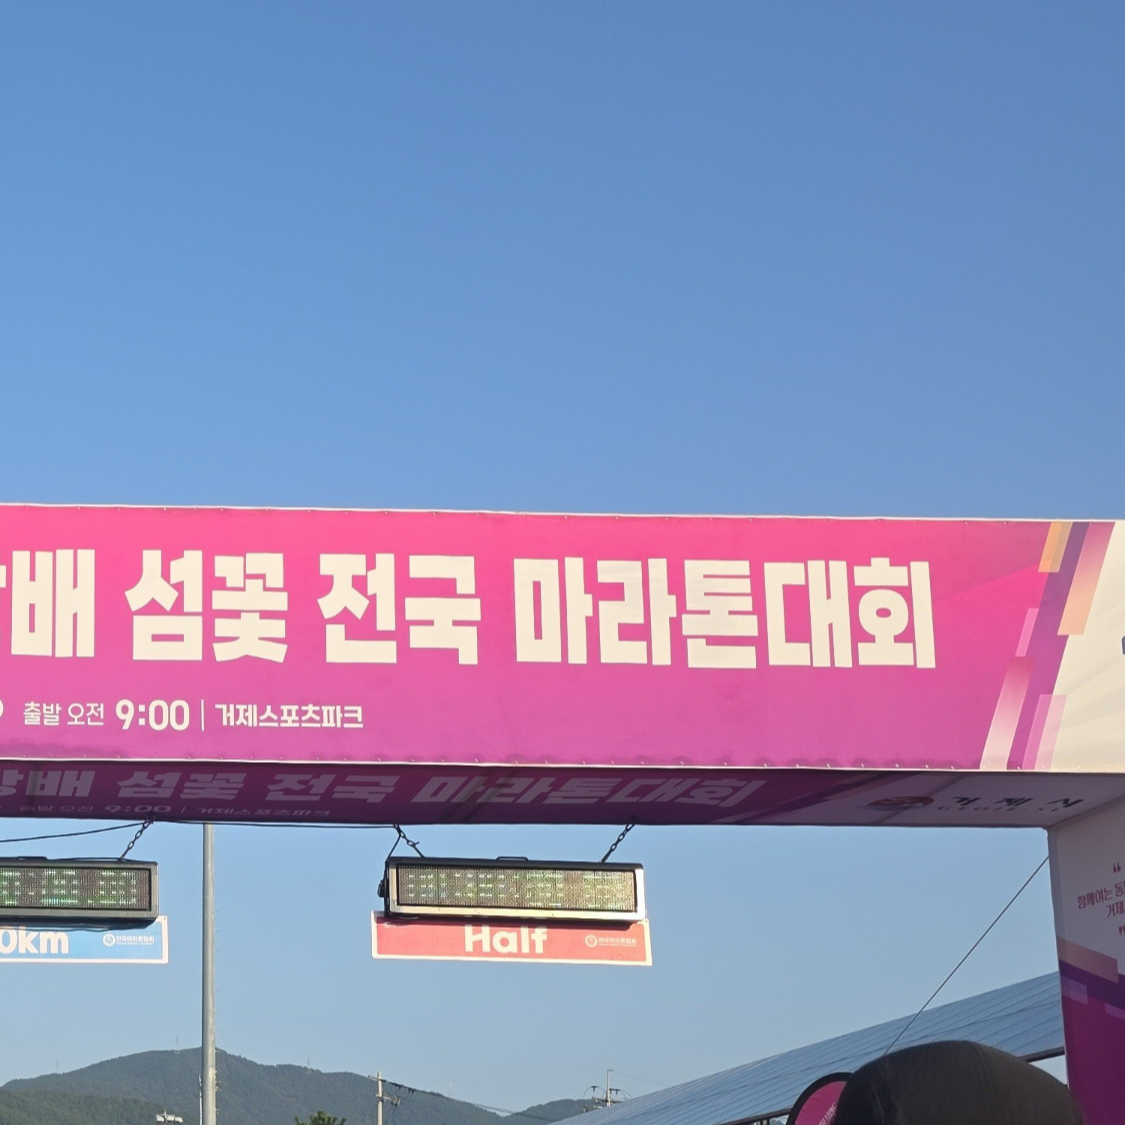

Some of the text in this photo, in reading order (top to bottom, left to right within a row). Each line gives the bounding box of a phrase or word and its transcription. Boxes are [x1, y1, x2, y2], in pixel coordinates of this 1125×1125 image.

[125, 548, 288, 663] 섬꽃
[317, 552, 481, 666] 전국
[513, 556, 936, 669] 마라톤대회
[23, 701, 62, 726] 출발
[67, 702, 104, 726] 오전
[116, 699, 190, 731] 9:00
[215, 703, 364, 730] 거제스포츠파크
[117, 770, 240, 801] 섬꽃
[264, 773, 396, 803] 전국
[411, 775, 767, 808] 마라톤대회
[1106, 900, 1125, 919] 거제
[464, 924, 548, 954] Half
